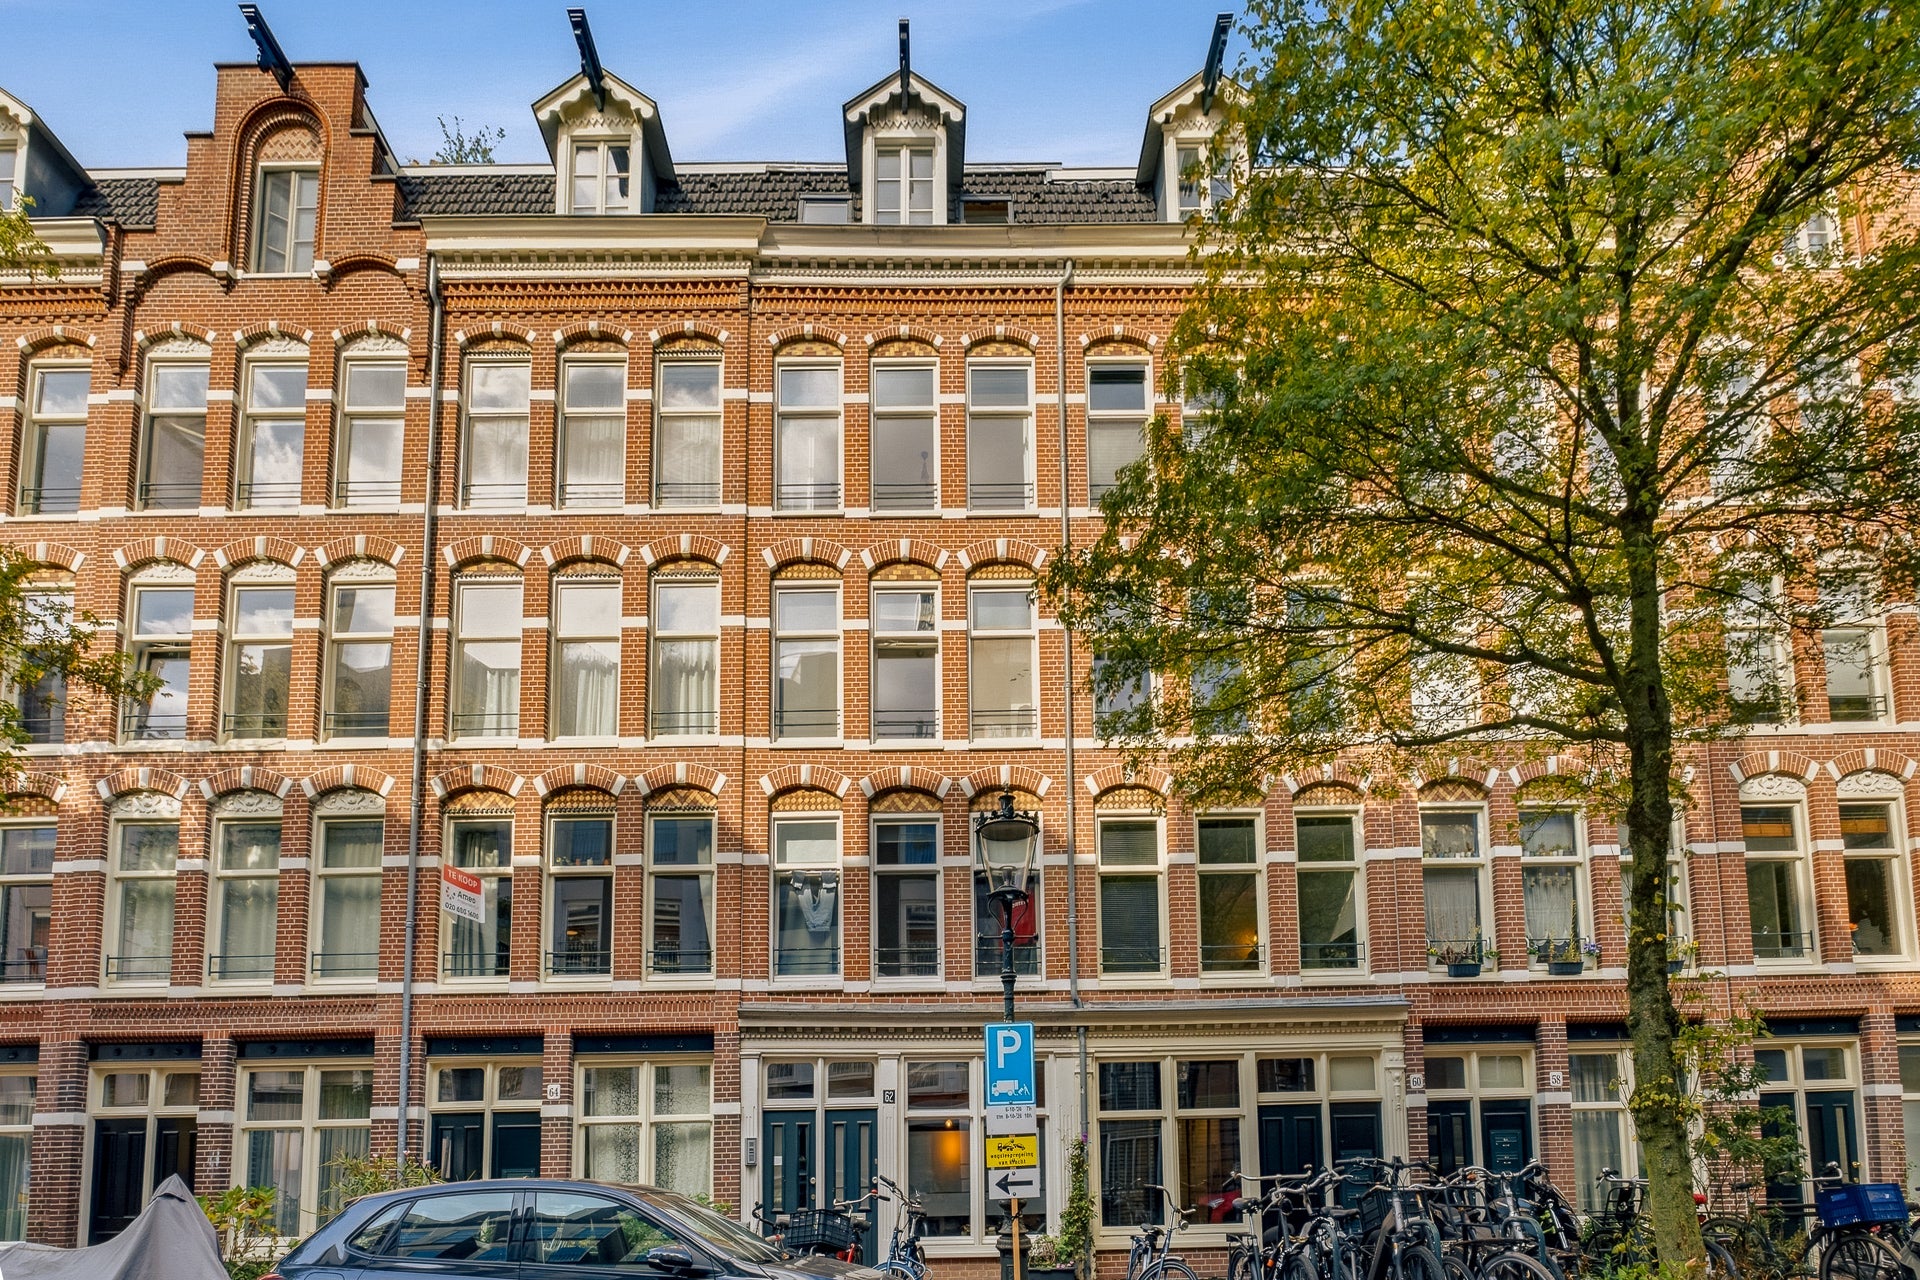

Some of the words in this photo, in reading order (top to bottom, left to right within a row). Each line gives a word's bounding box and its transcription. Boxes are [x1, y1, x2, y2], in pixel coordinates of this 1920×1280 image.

[448, 869, 457, 880] TE
[459, 874, 478, 888] KOOP
[997, 1029, 1022, 1069] P
[1412, 1076, 1422, 1087] 60
[1551, 1074, 1561, 1085] 58
[549, 1087, 559, 1098] 64
[884, 1091, 894, 1103] 62
